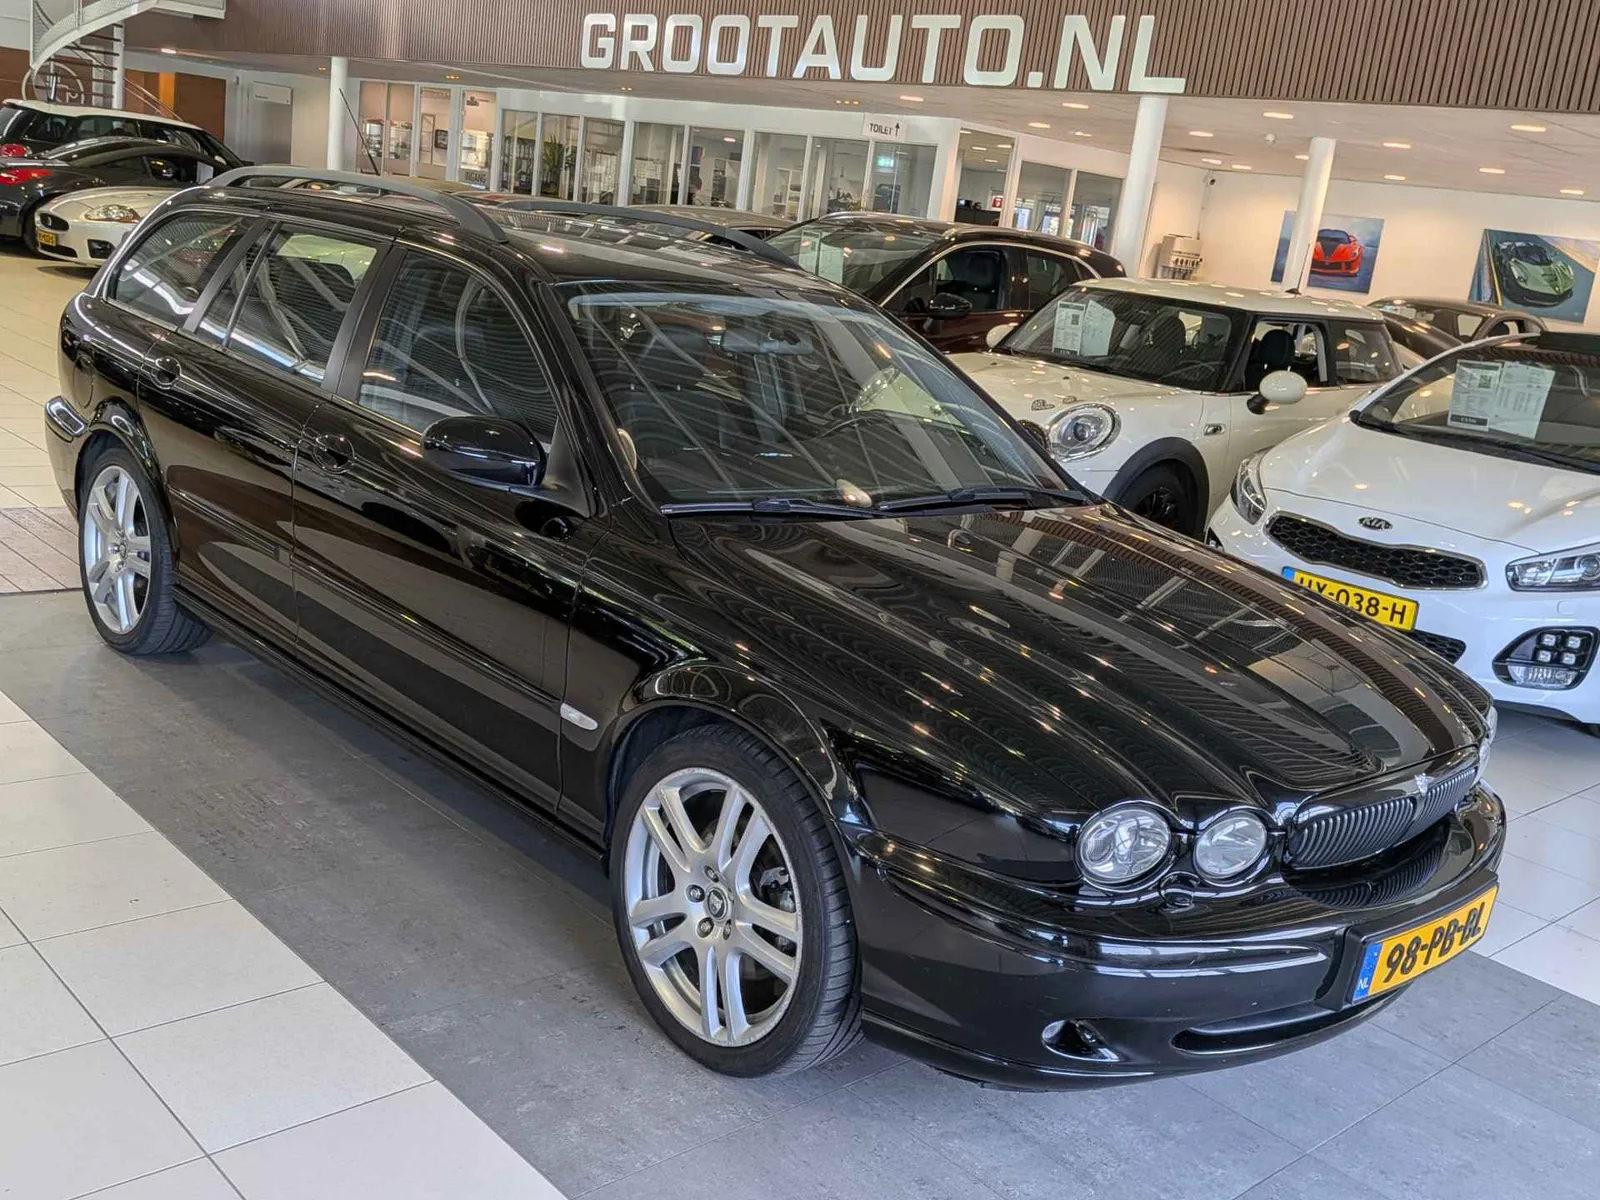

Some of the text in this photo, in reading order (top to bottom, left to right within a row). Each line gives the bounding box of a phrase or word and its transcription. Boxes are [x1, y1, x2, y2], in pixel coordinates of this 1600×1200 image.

[581, 14, 1186, 94] GROOTAUTO.NL
[869, 123, 893, 135] TOILET
[1362, 517, 1387, 529] KIA
